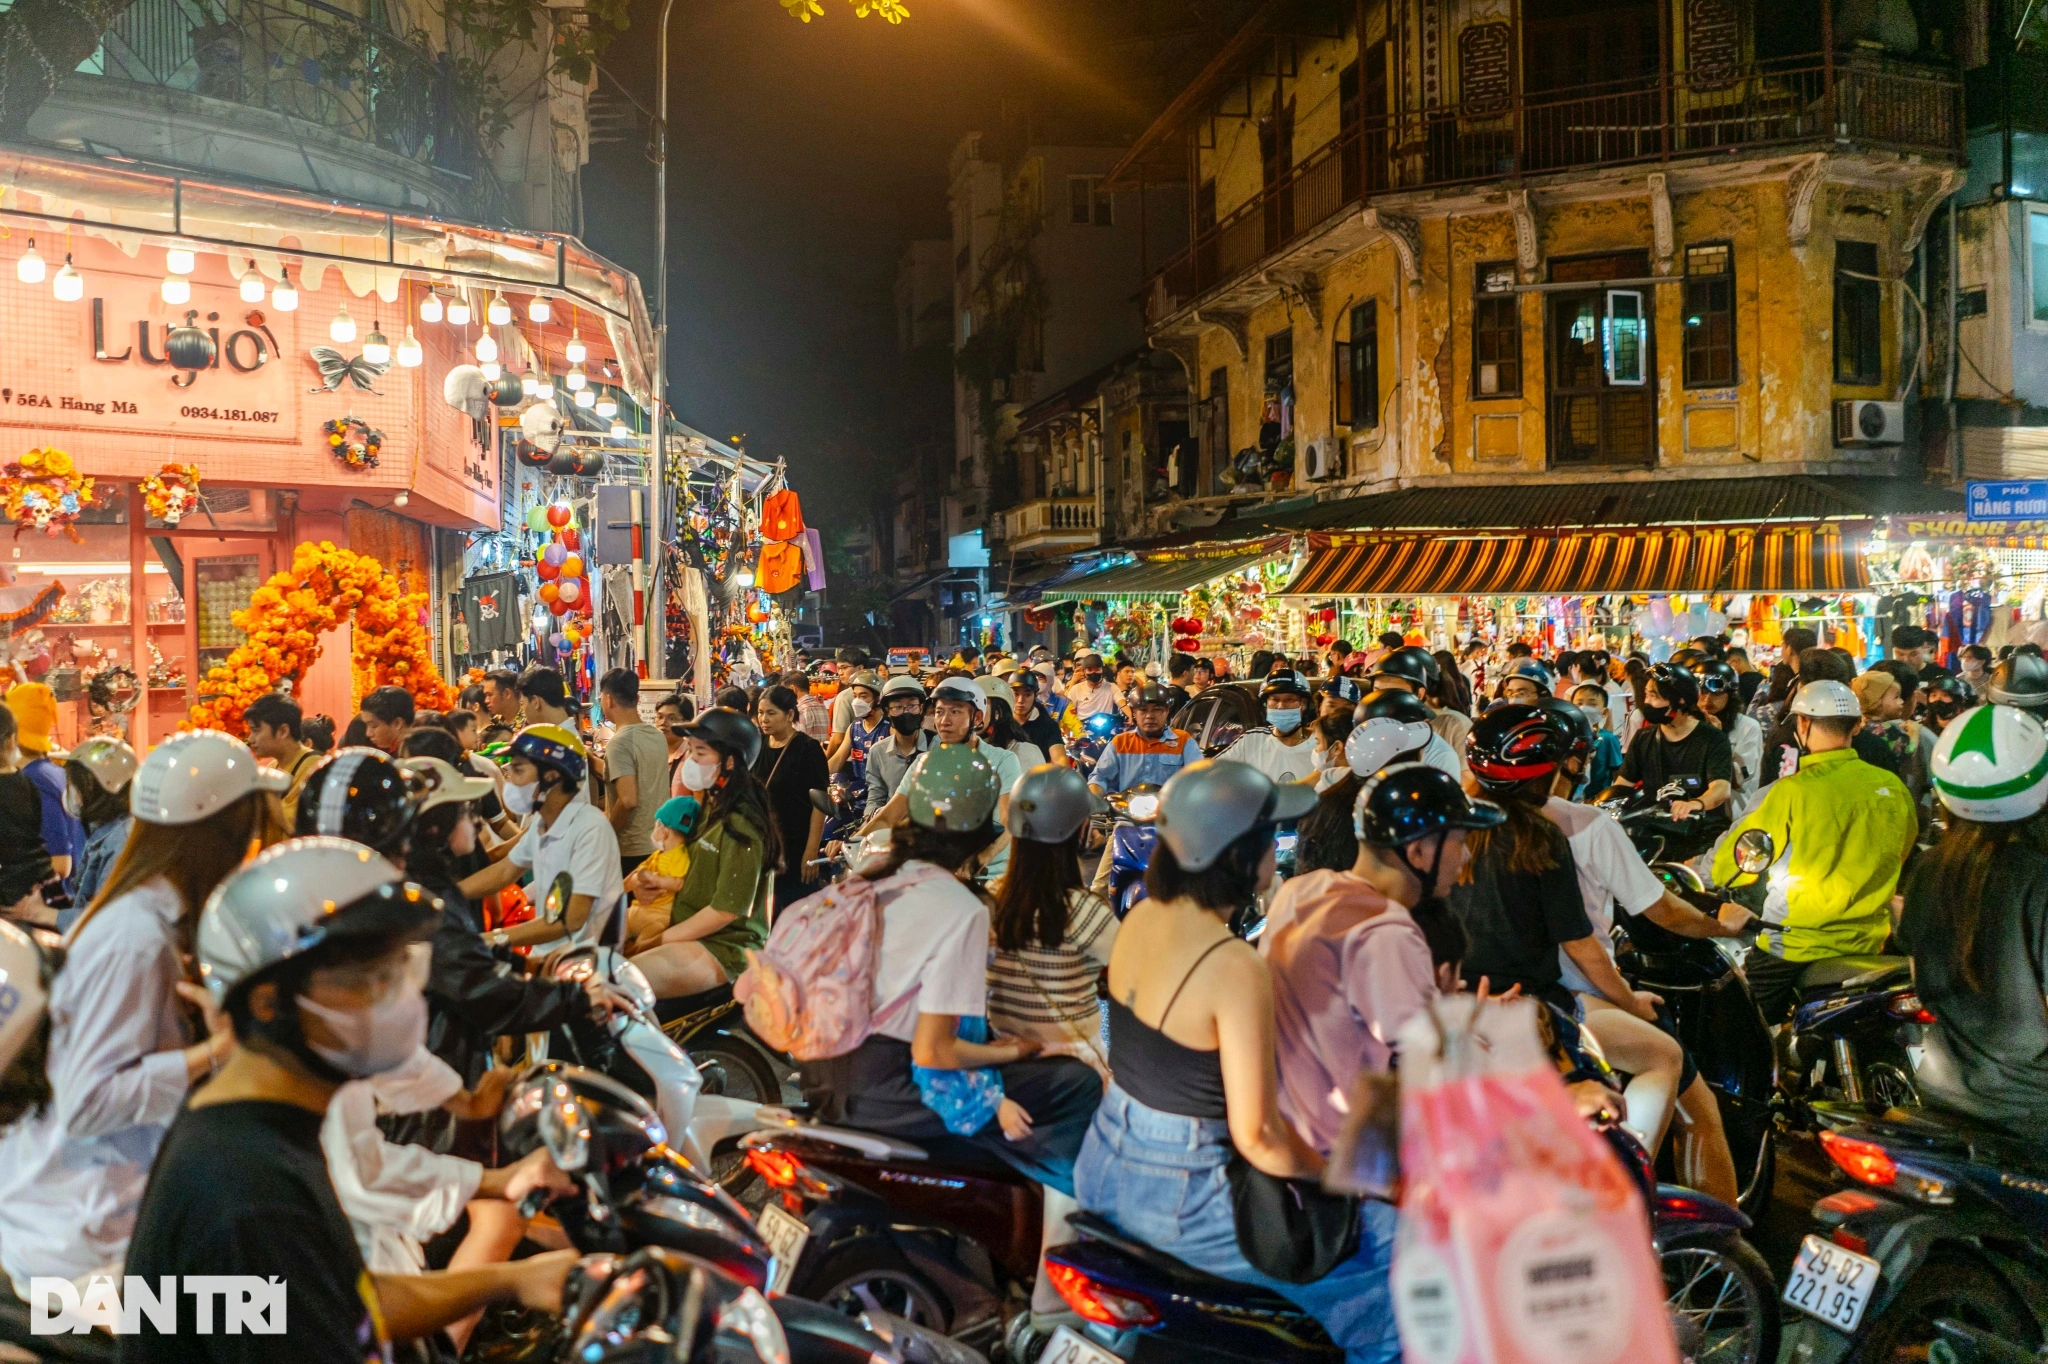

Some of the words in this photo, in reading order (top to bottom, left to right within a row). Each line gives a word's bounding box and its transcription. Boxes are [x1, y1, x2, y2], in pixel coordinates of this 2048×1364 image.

[17, 393, 53, 408] 58A
[180, 406, 279, 423] 0934.181.087
[1789, 1273, 1859, 1325] 221.95
